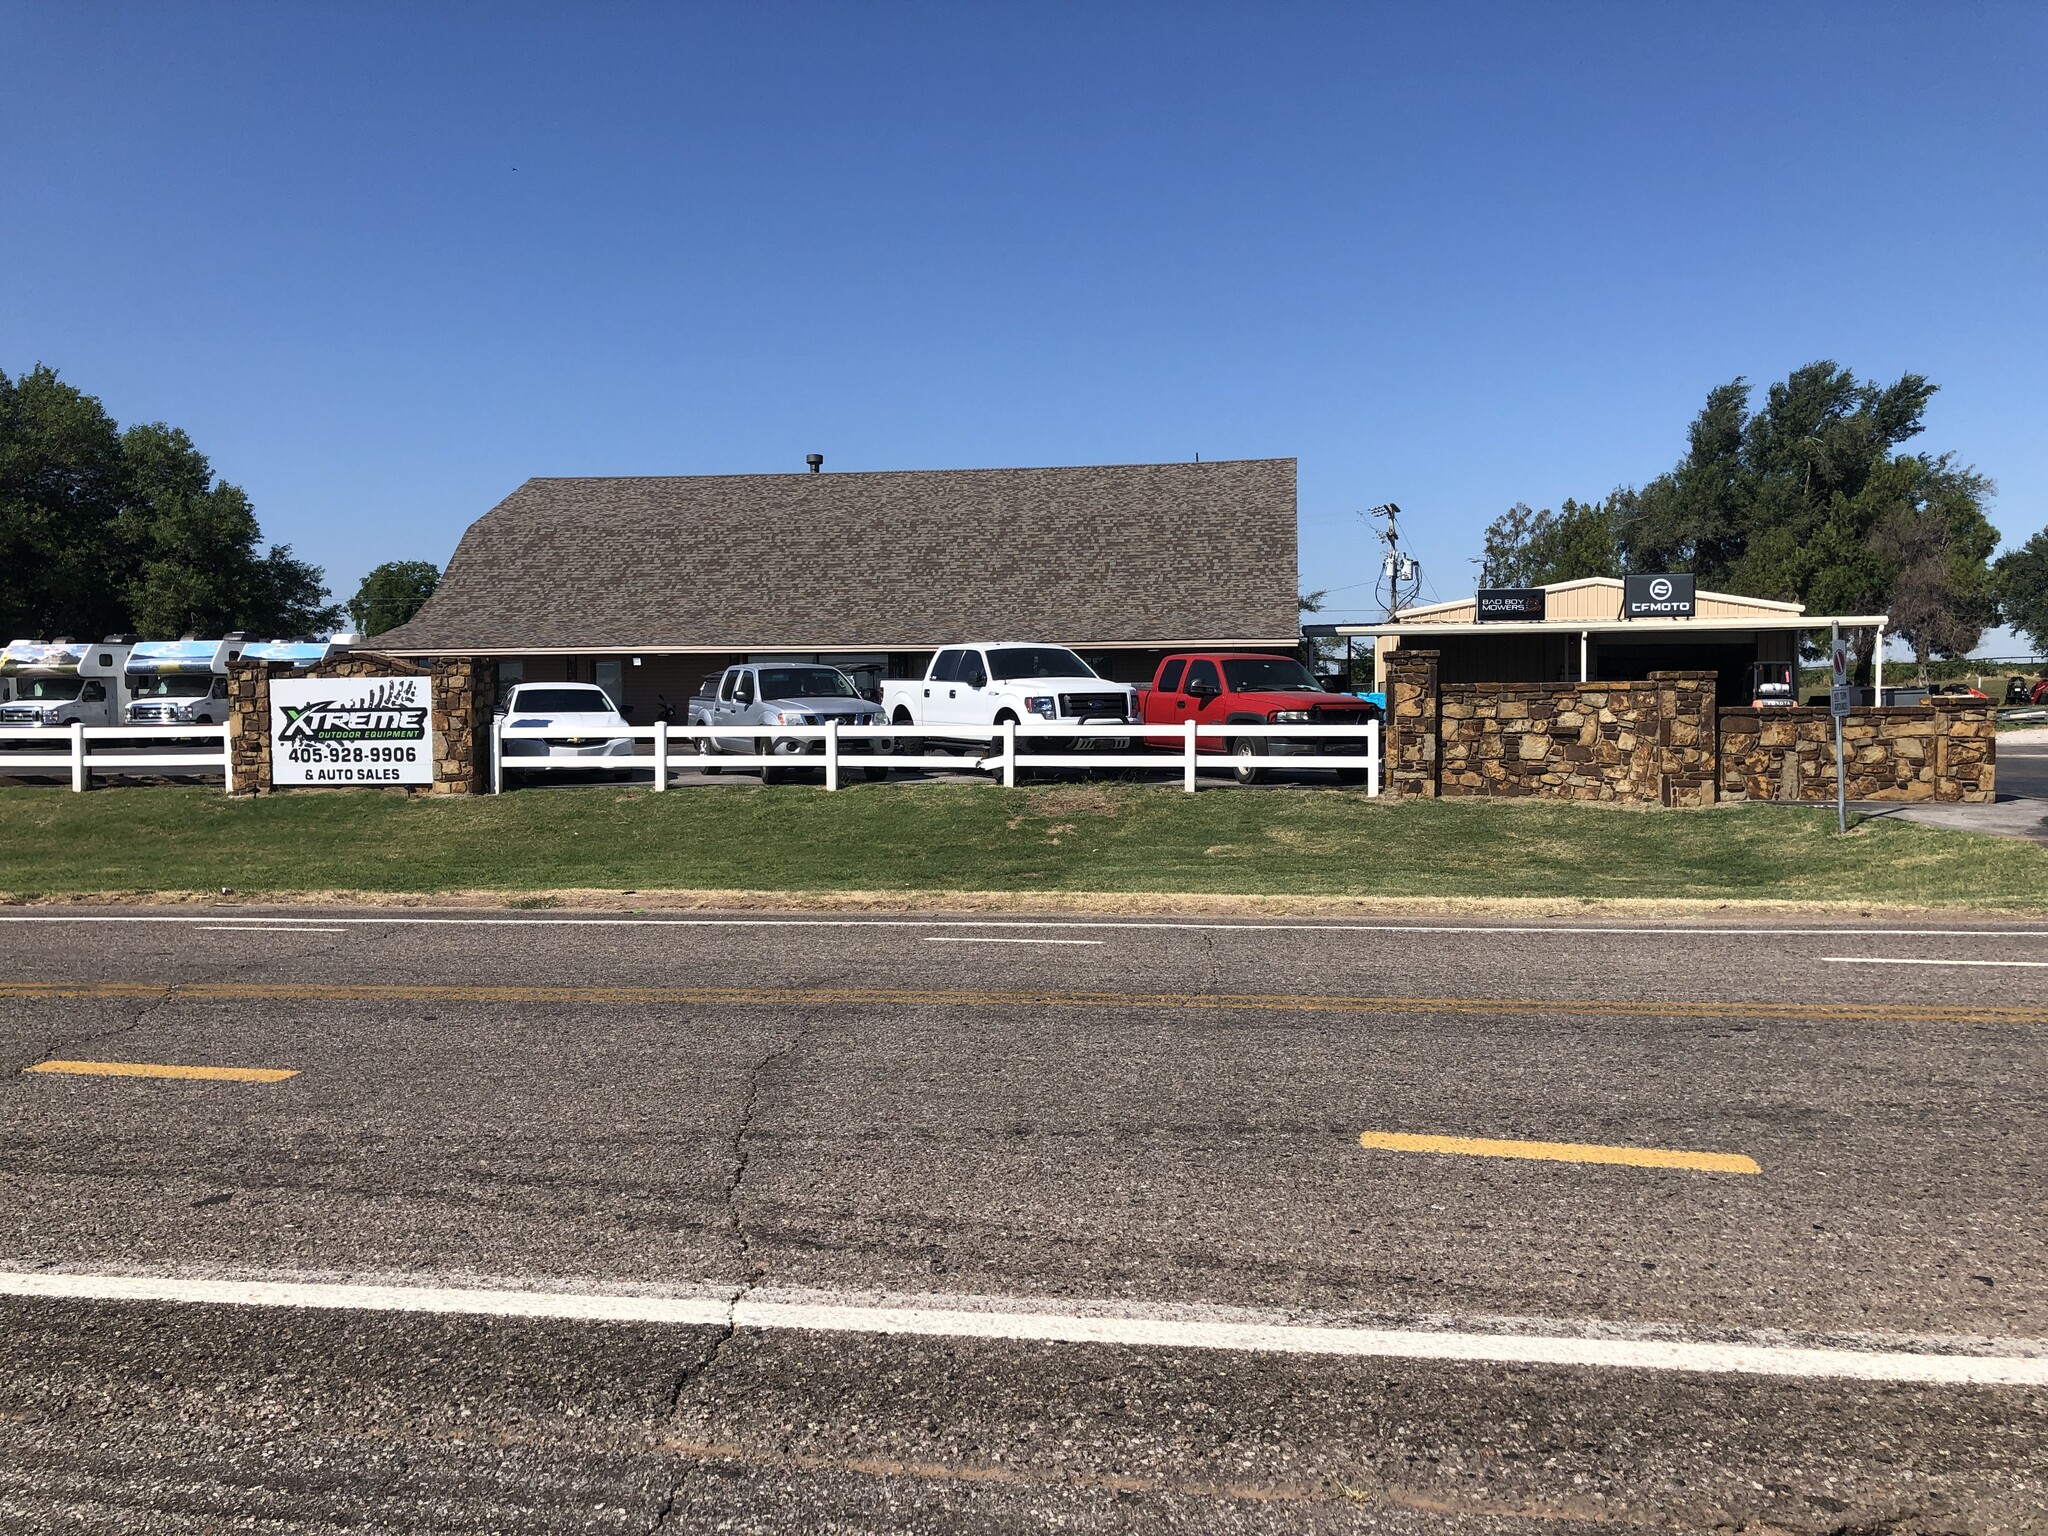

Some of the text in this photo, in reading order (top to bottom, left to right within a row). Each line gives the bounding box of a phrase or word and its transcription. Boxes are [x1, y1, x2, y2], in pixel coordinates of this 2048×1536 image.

[1632, 602, 1690, 611] CFMOTO
[284, 703, 422, 736] XTREME
[318, 730, 420, 739] OUTDOOR EQUIPMENT
[288, 747, 417, 763] 405-928-9906
[305, 769, 400, 780] & AUTO SALES
